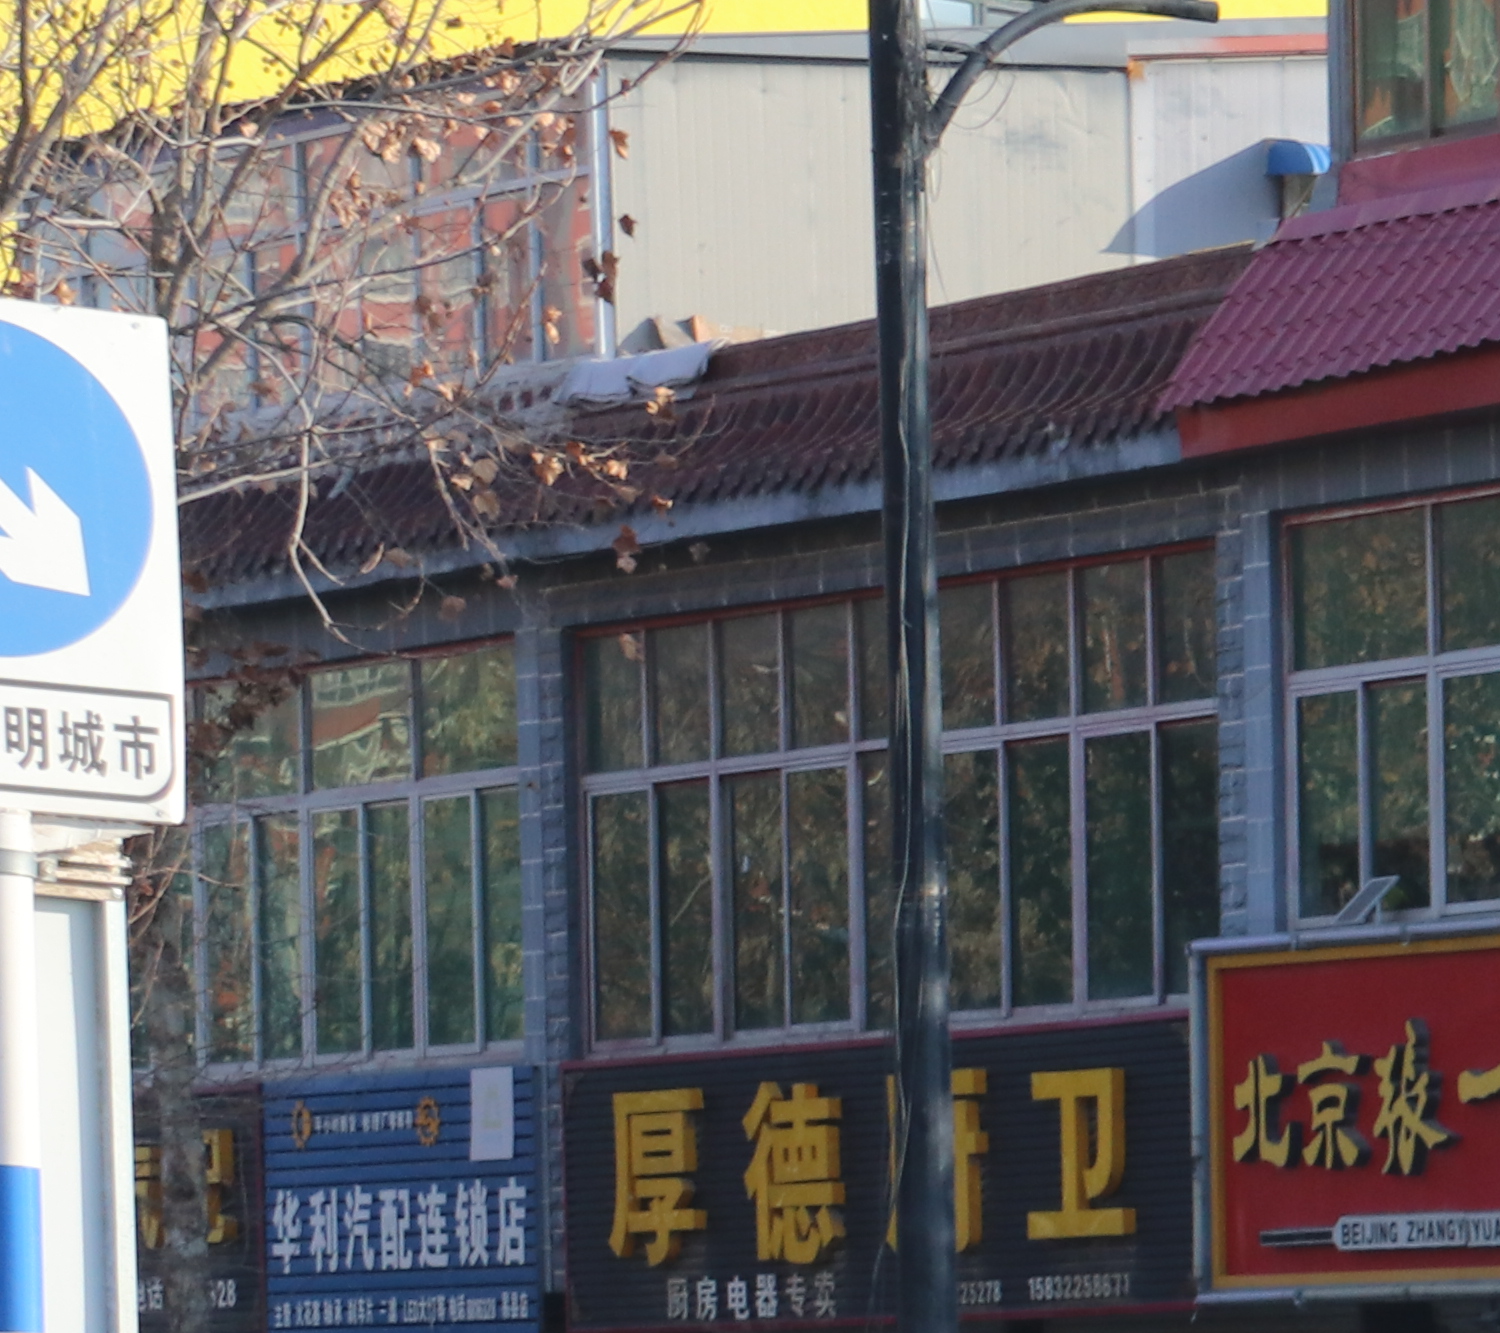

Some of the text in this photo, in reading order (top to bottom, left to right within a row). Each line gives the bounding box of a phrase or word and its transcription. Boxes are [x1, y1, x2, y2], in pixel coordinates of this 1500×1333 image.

[3, 706, 161, 780] 明城市
[608, 1068, 1137, 1267] 厚德卫
[272, 1176, 527, 1275] 华利汽配连锁店
[1341, 1222, 1398, 1245] BEIJING
[666, 1273, 837, 1320] 厨房电器专卖
